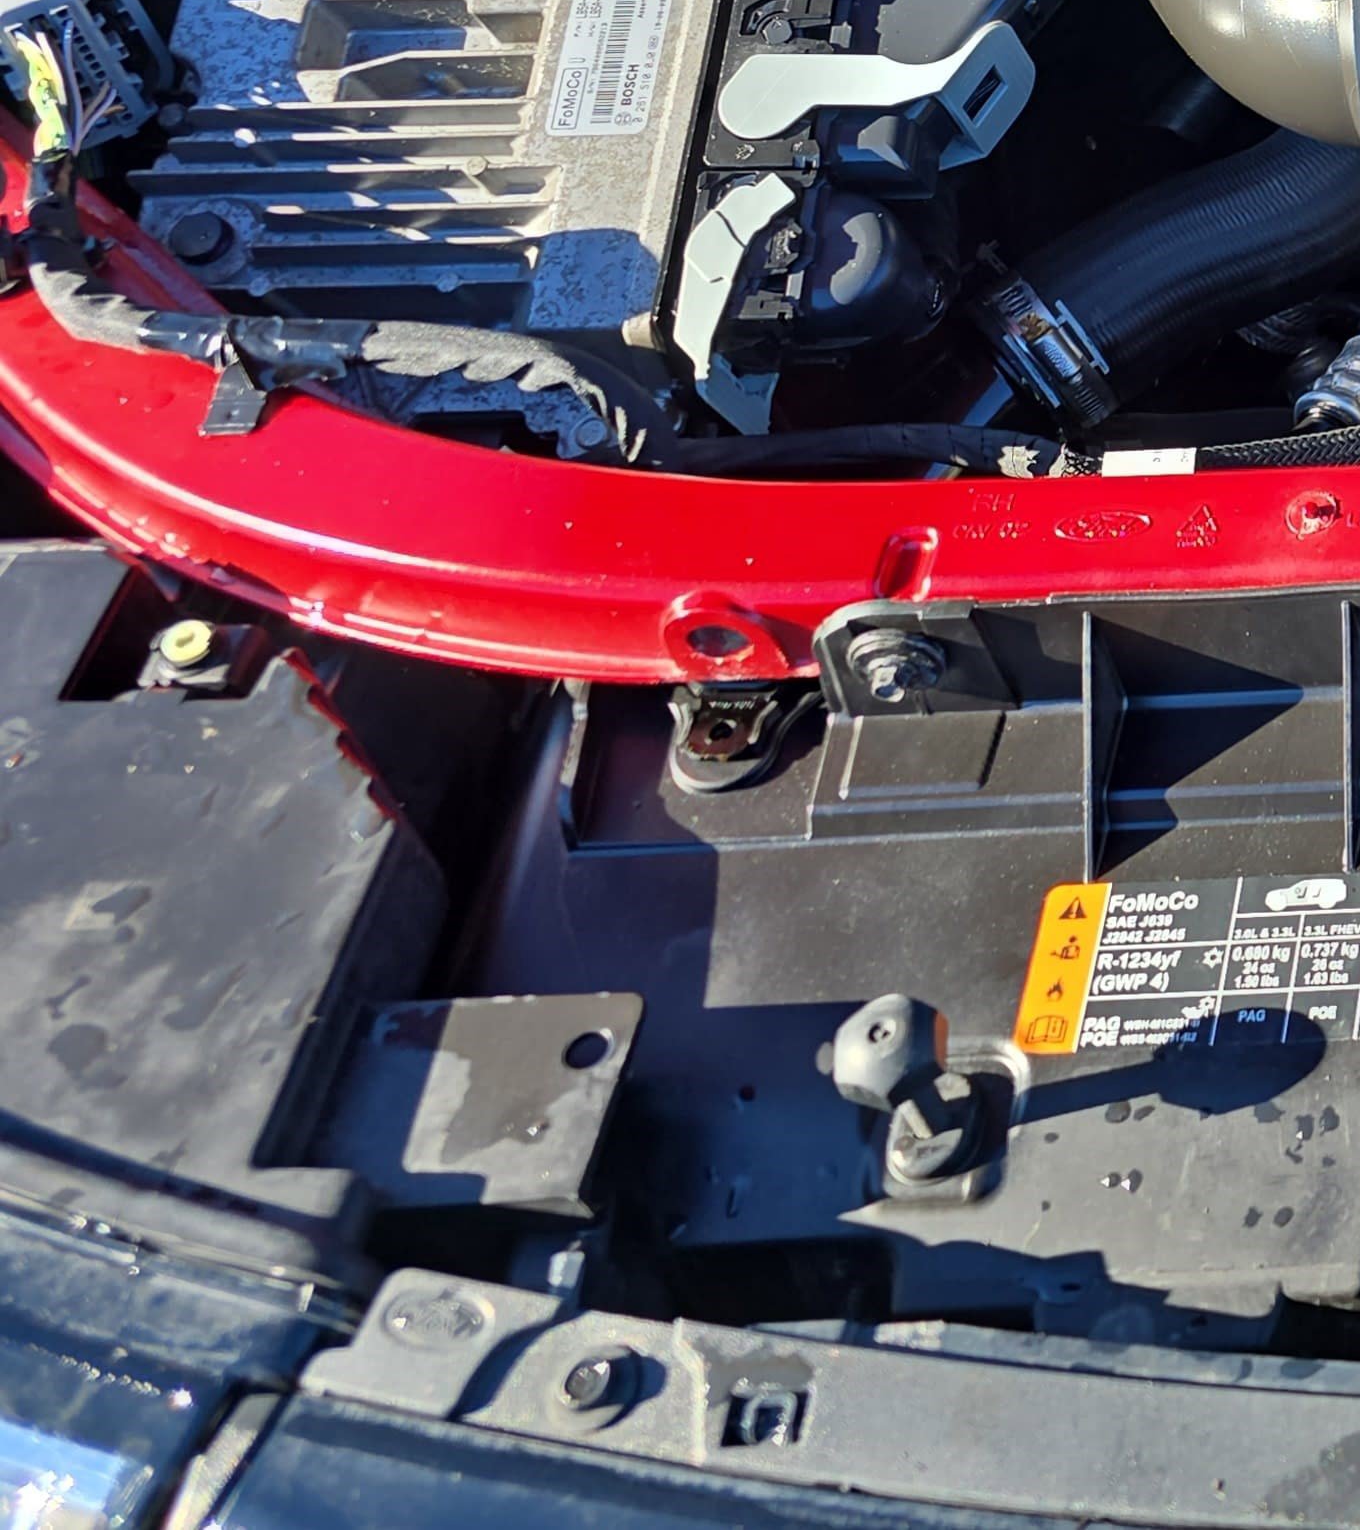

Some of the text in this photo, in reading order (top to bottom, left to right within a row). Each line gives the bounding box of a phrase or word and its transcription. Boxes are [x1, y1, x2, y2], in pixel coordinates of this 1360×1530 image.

[620, 64, 640, 106] BOSCH
[558, 70, 582, 127] FoMoCo
[1108, 891, 1199, 913] FoMoCo
[1105, 916, 1138, 929] SAE
[1272, 944, 1291, 962] kg
[1301, 942, 1359, 959] 0.737 kg
[1097, 950, 1182, 971] R-1234yf
[1328, 960, 1344, 971] oz
[1092, 972, 1169, 995] (GWP 4)
[1329, 971, 1349, 984] lbs
[1238, 1009, 1266, 1023] PAG
[1308, 1005, 1338, 1020] POE
[1082, 1016, 1120, 1031] PAG
[1079, 1030, 1120, 1048] POE
